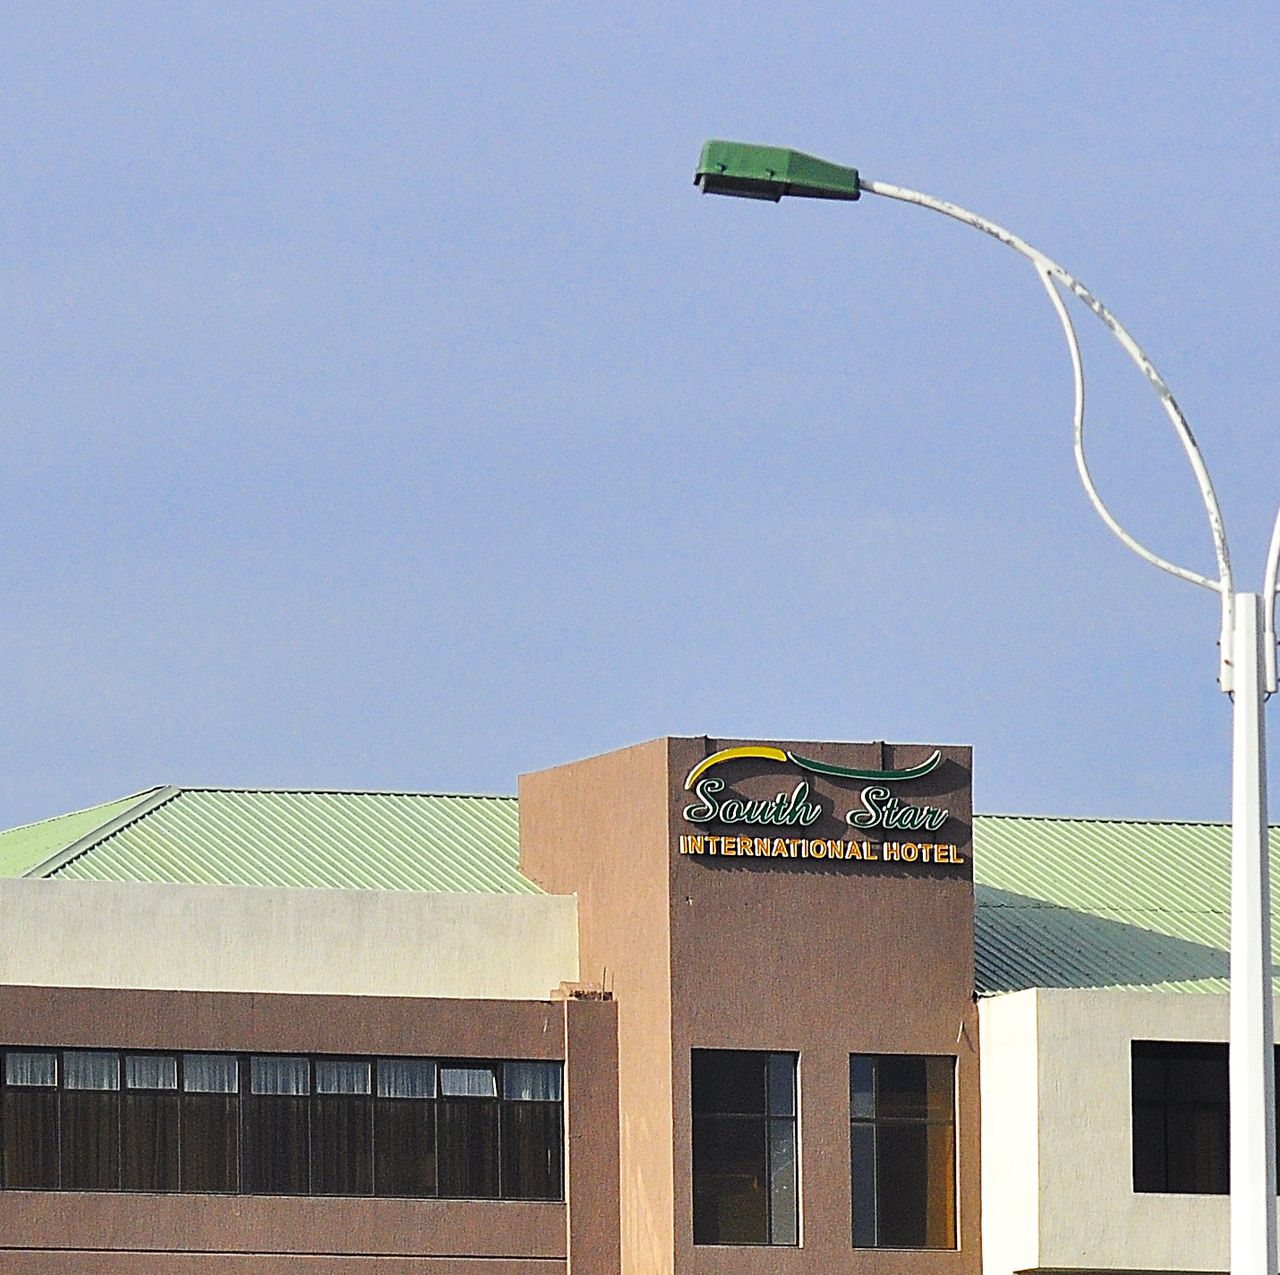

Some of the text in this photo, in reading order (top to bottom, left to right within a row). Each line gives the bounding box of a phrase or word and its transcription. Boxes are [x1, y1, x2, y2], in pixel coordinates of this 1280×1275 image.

[683, 777, 949, 831] South Star
[679, 834, 965, 864] INTERNATIONAL HOTEL
